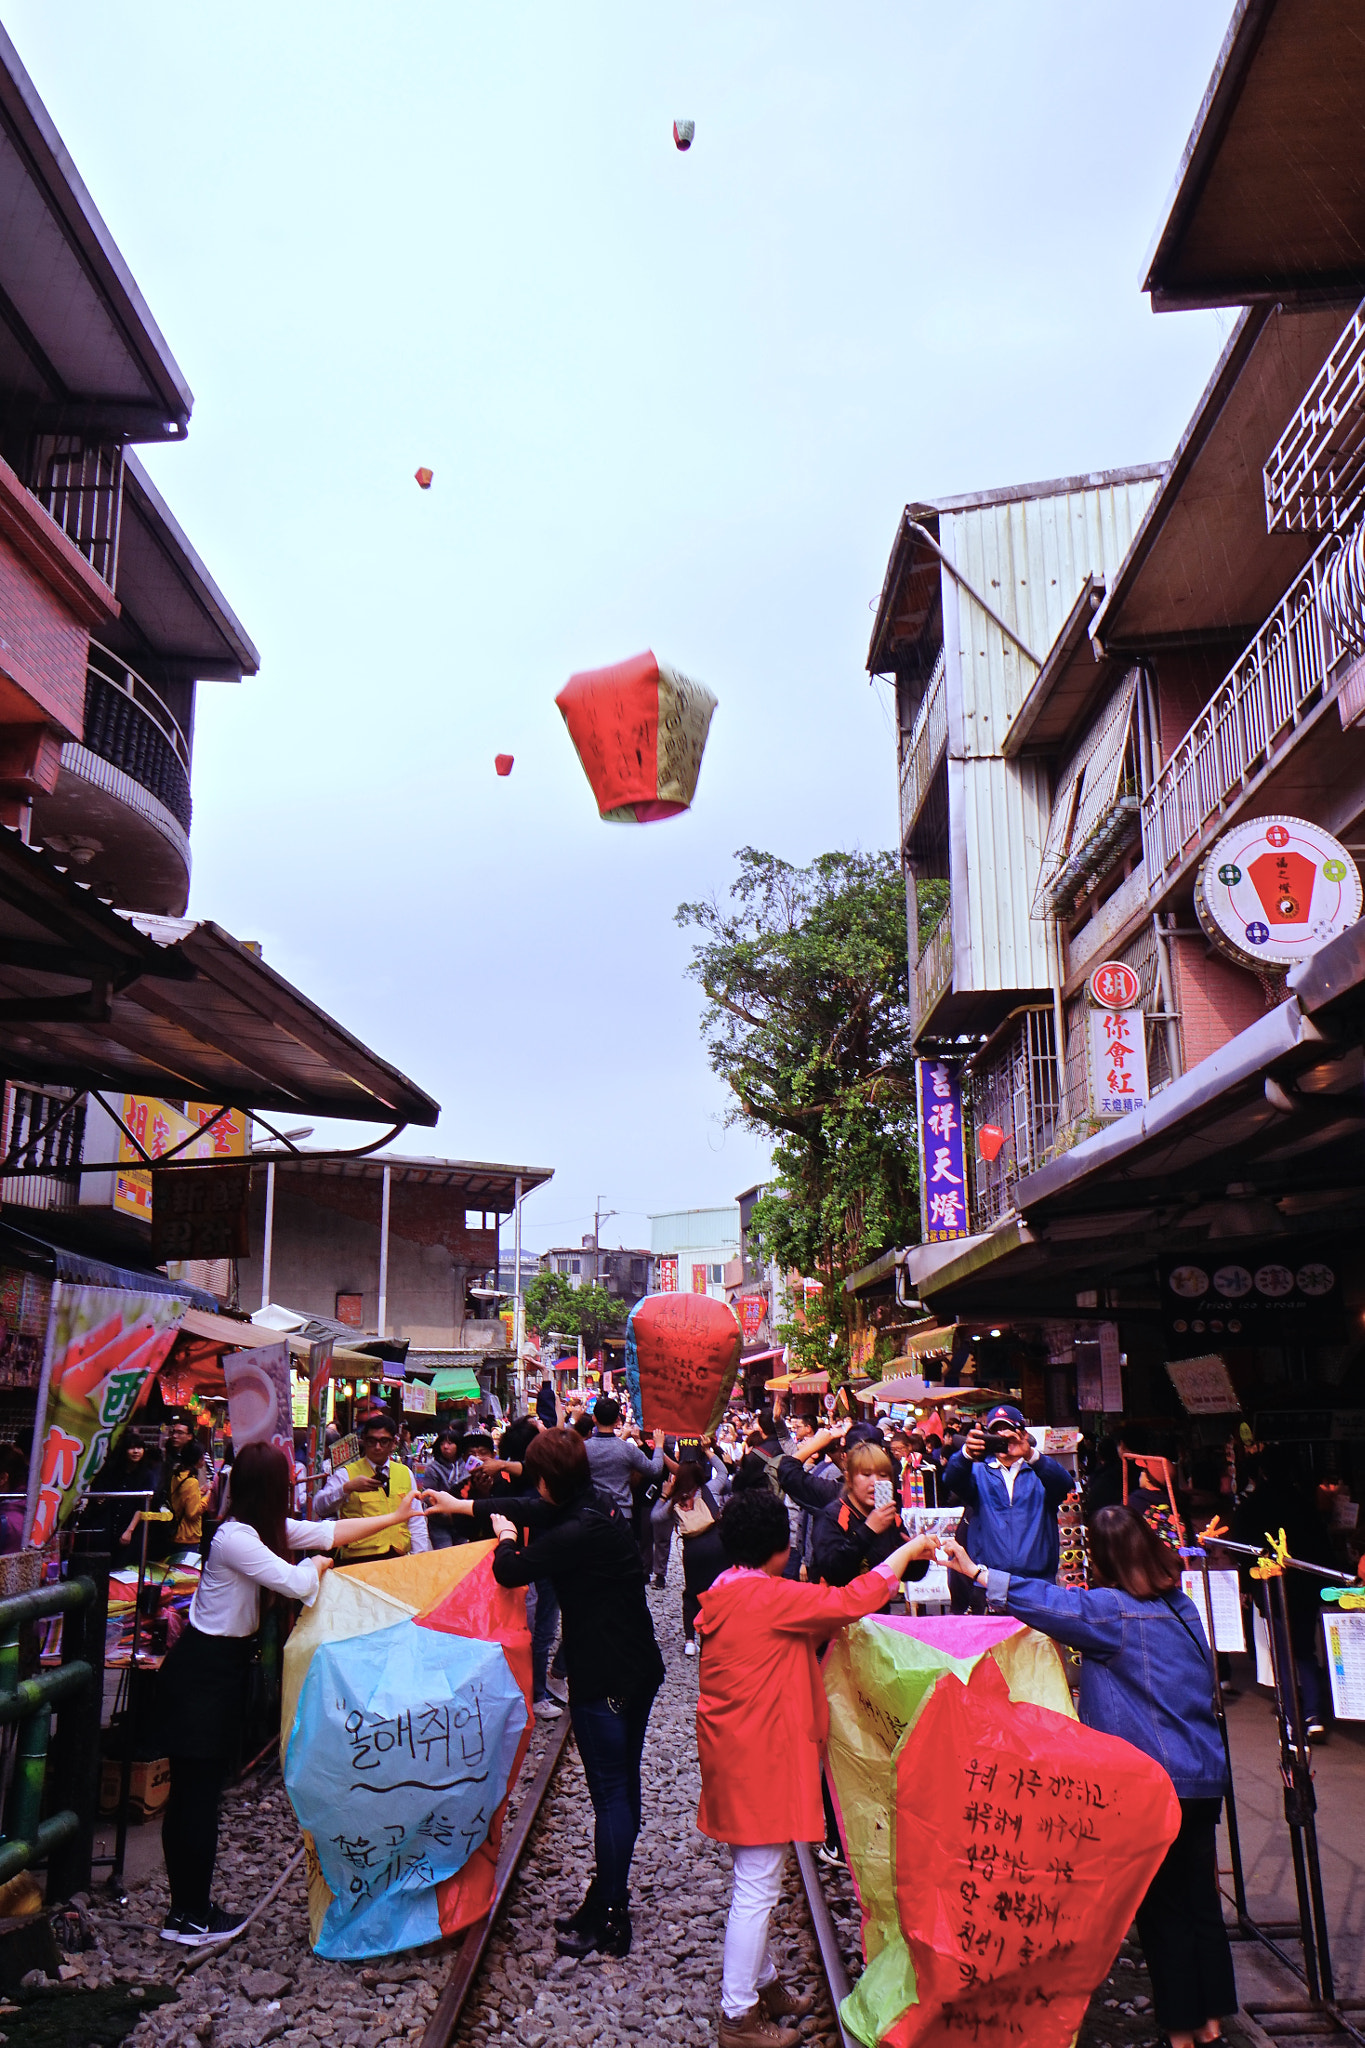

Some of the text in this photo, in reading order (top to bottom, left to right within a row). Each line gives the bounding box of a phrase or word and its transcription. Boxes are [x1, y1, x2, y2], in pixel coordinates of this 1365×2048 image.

[1102, 971, 1127, 999] 胡
[1103, 1014, 1135, 1094] 你會紅
[927, 1062, 965, 1227] 吉祥天燈
[964, 1759, 998, 1793] 우리
[1008, 1768, 1043, 1800] 가족
